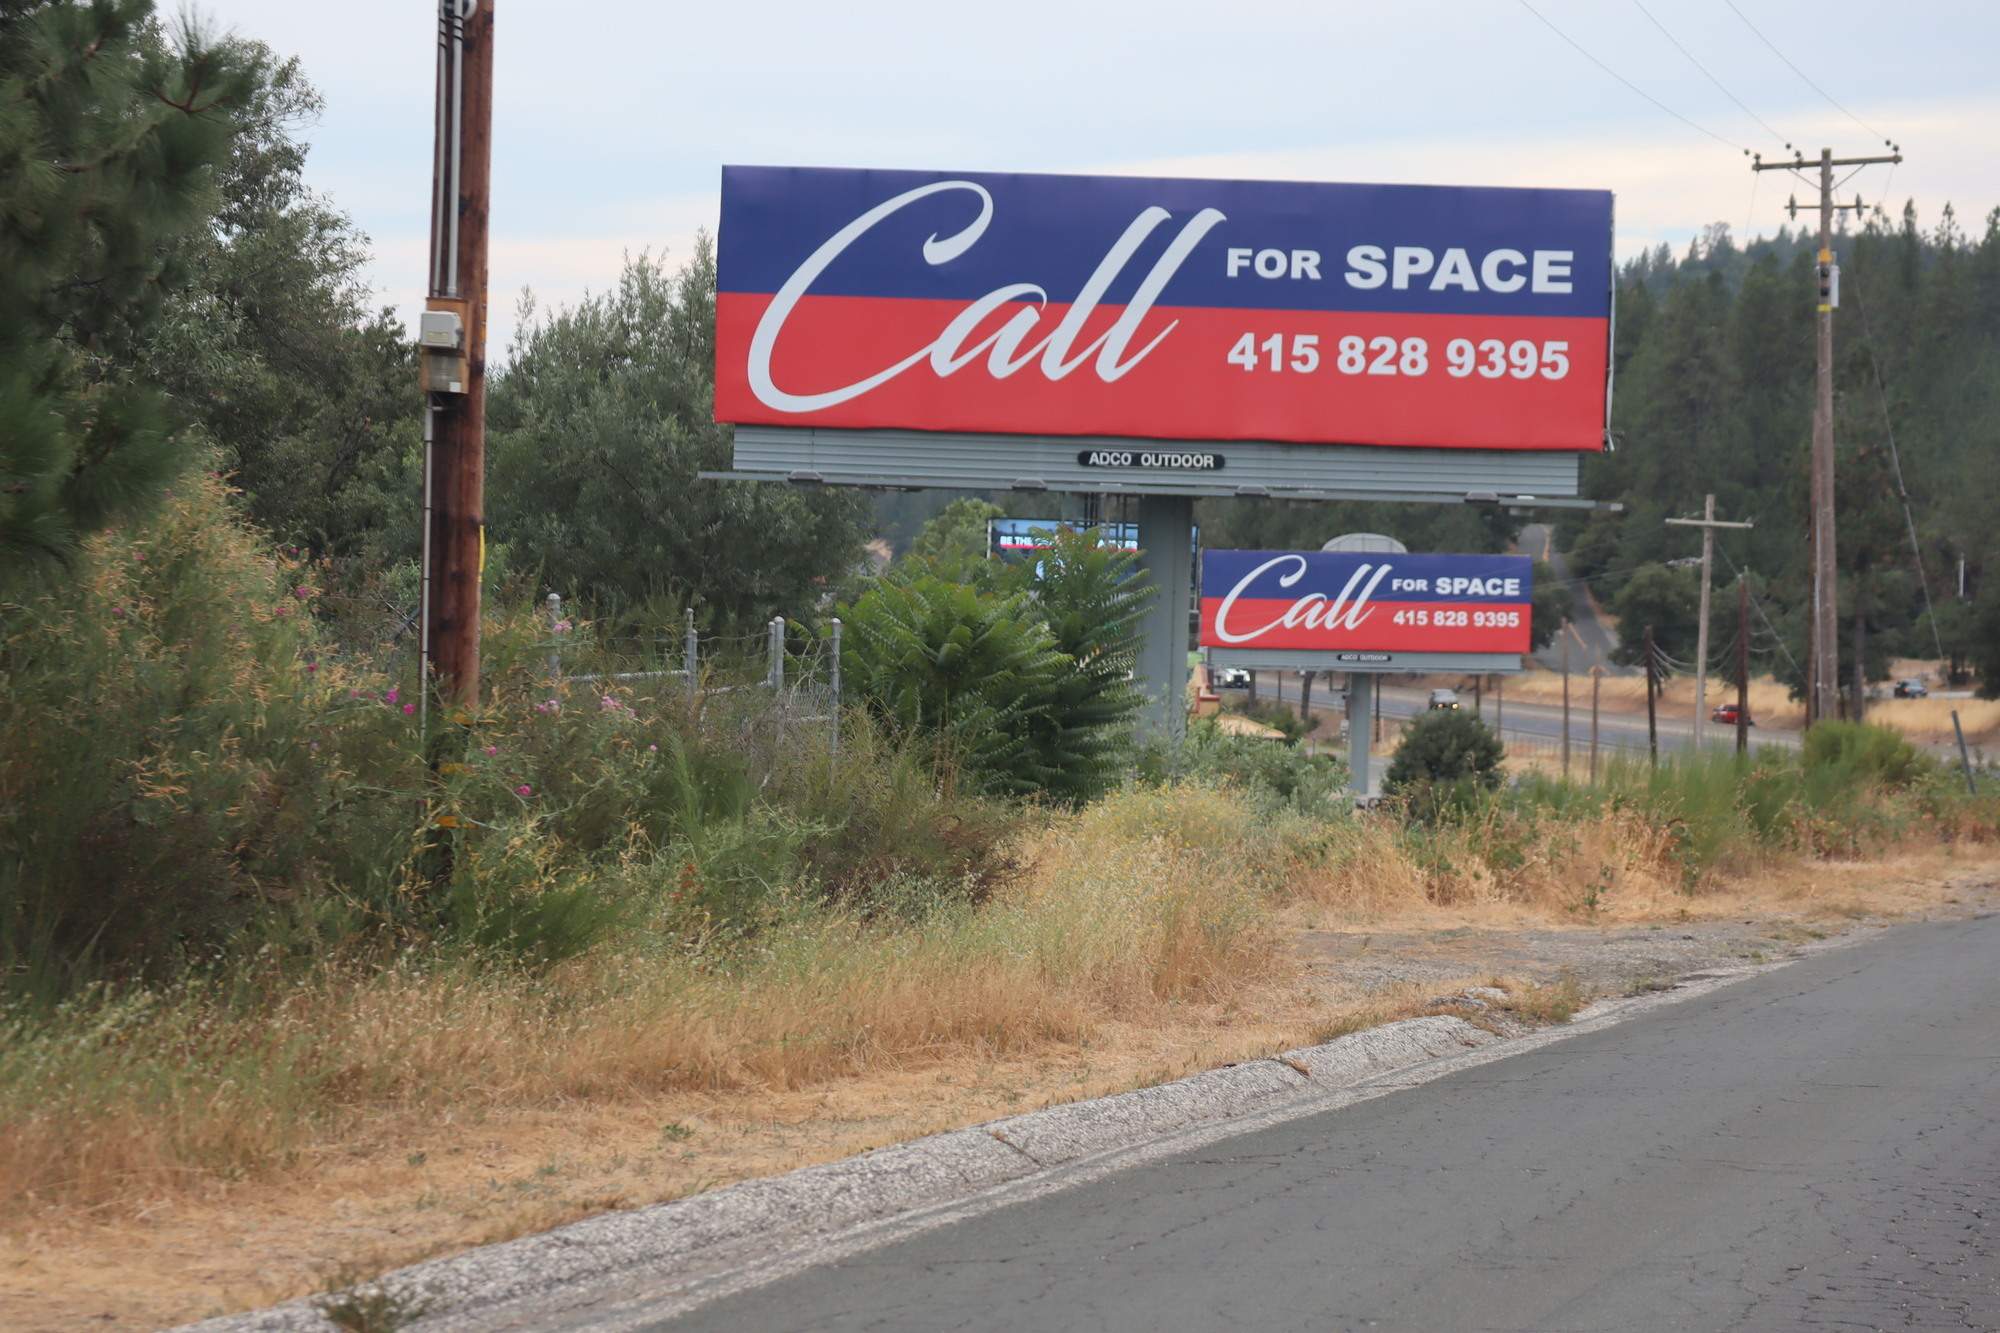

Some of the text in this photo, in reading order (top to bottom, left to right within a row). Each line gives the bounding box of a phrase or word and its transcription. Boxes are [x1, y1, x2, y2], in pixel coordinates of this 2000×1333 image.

[1226, 245, 1574, 295] FOR SPACE
[748, 180, 1226, 412] Call
[1227, 332, 1570, 381] 415 828 9395
[1088, 451, 1215, 468] ADCO OUTDOOR
[1215, 554, 1392, 643] Call
[1391, 577, 1521, 597] FOR SPACE
[1392, 609, 1520, 628] 415 828 9395
